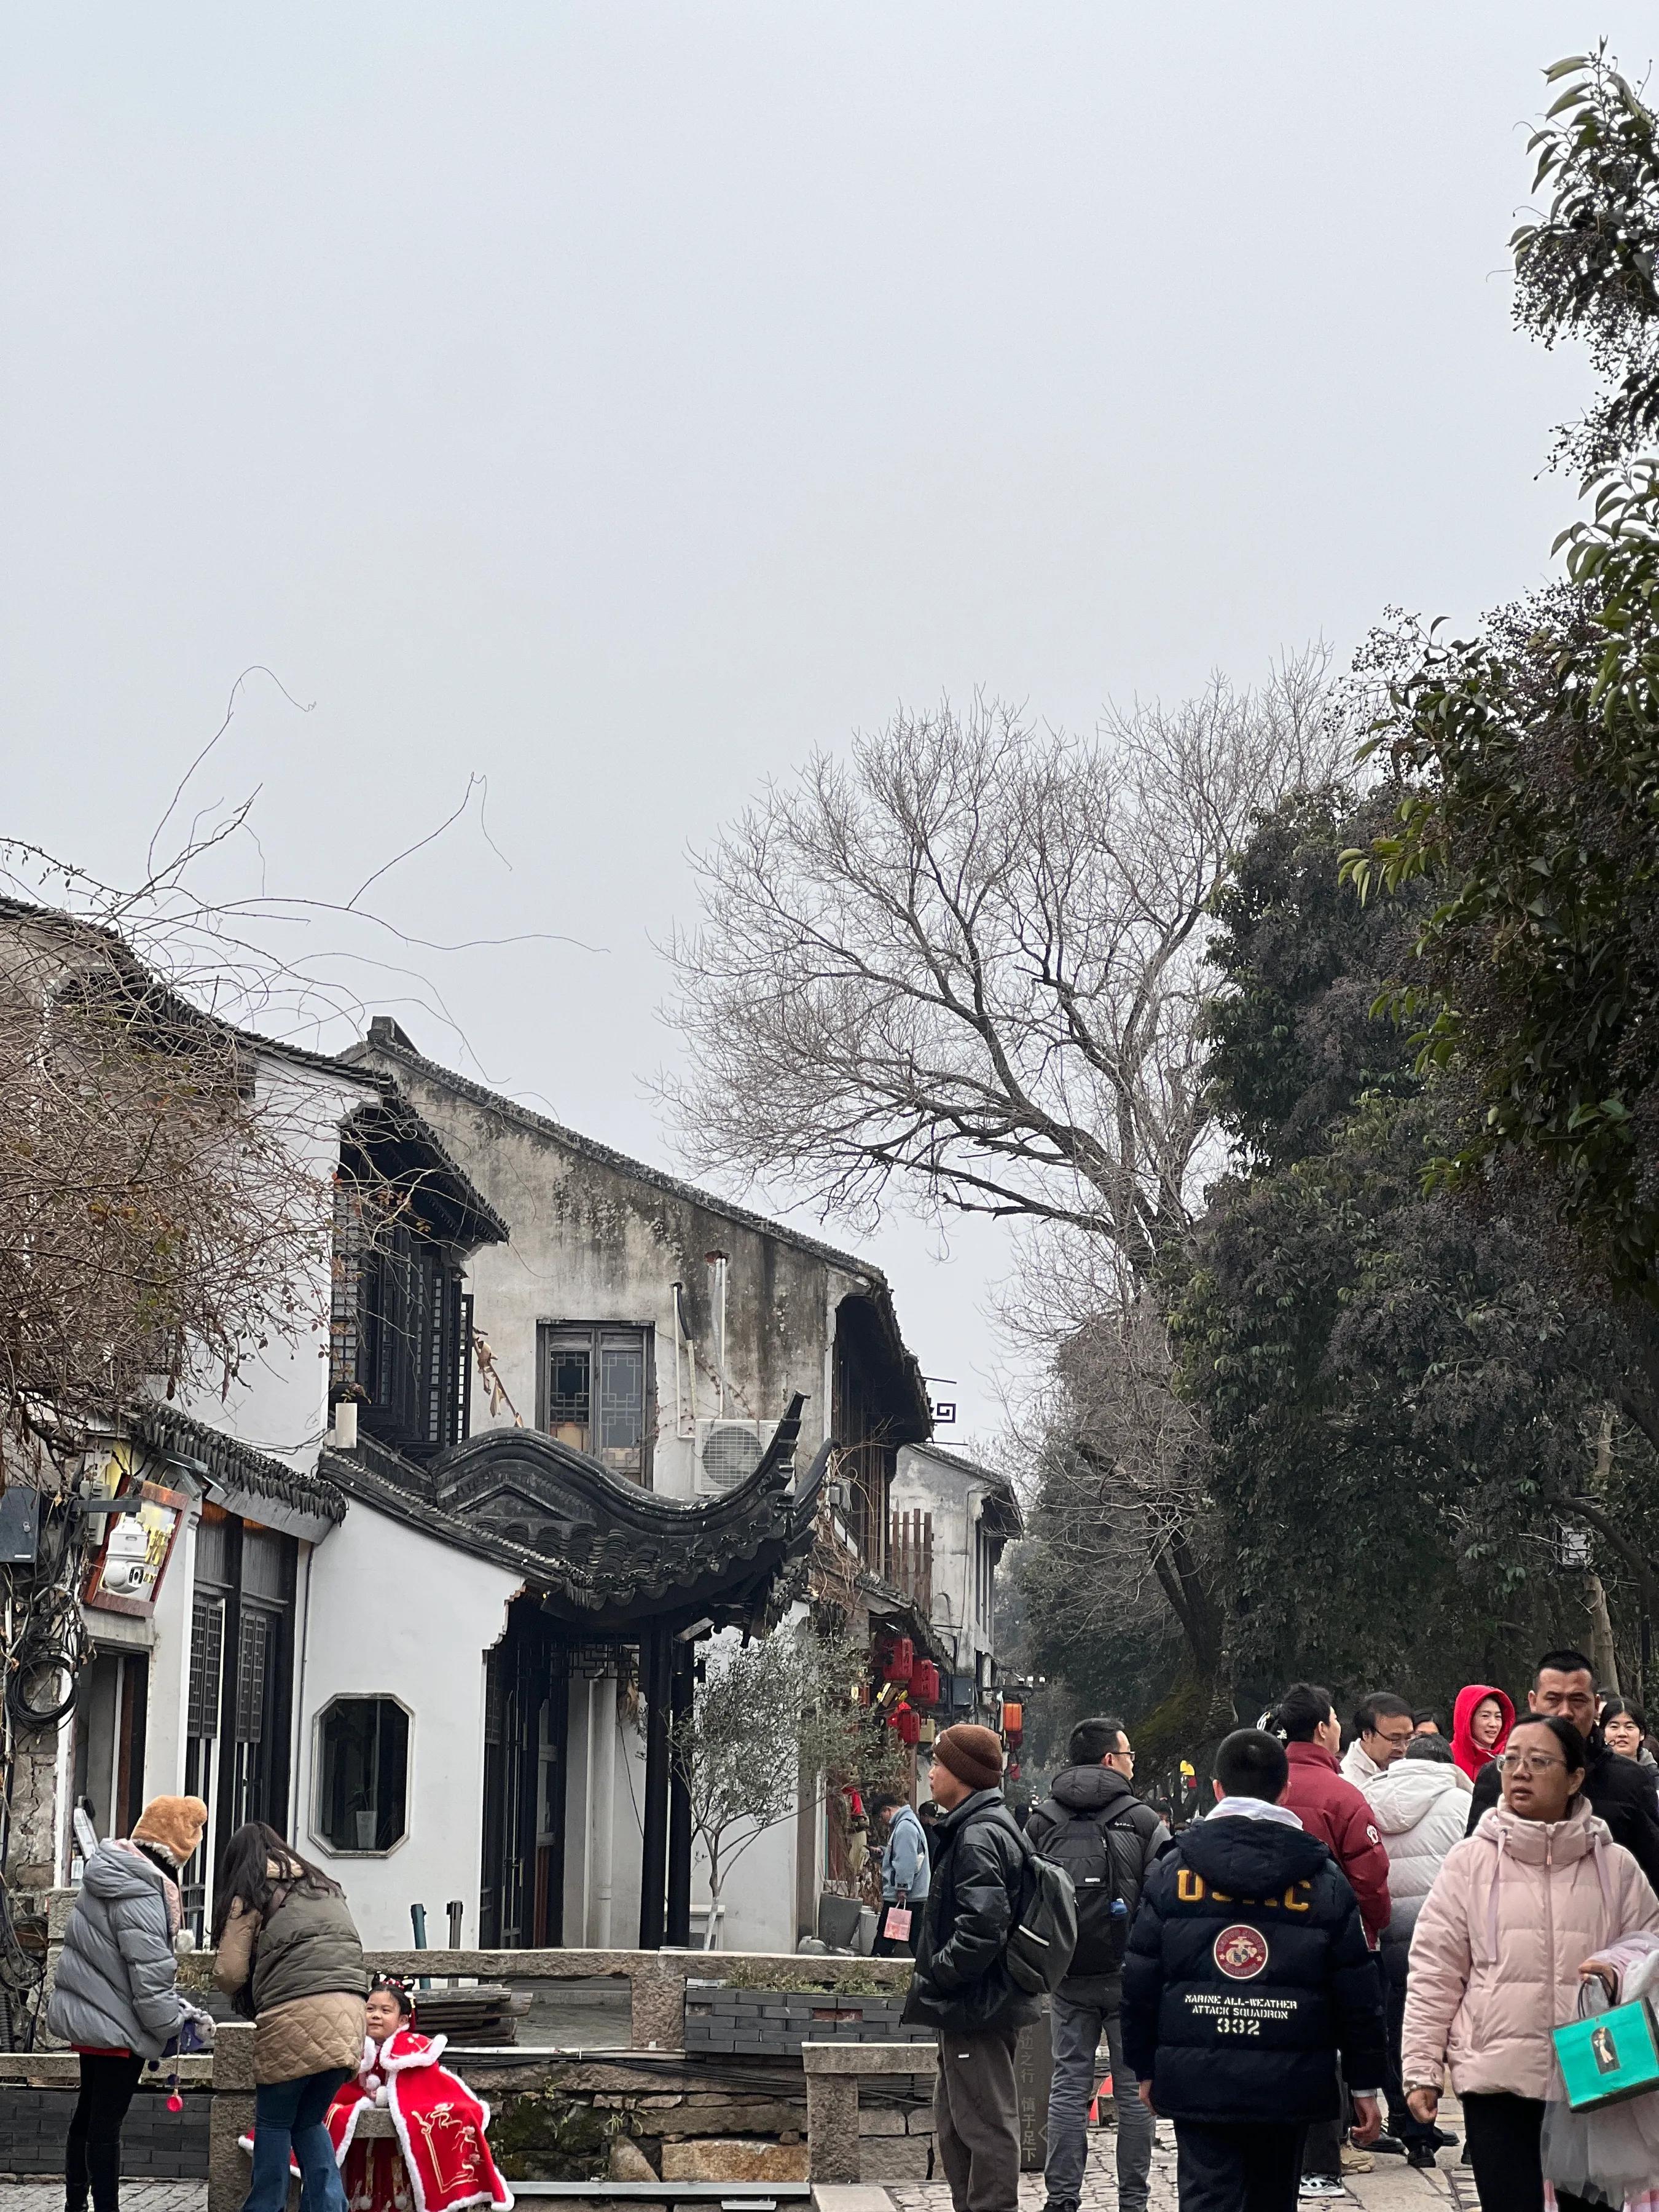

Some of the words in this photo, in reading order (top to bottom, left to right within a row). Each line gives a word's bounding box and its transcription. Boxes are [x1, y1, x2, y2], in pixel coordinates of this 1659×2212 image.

[1177, 1870, 1311, 1912] UC
[1185, 1994, 1222, 2004] MARINE
[1224, 1996, 1298, 2010] ALL-WEATHER
[1192, 2005, 1229, 2015] ATTACK
[1233, 2007, 1288, 2019] SQUADRON
[1217, 2017, 1260, 2035] 332
